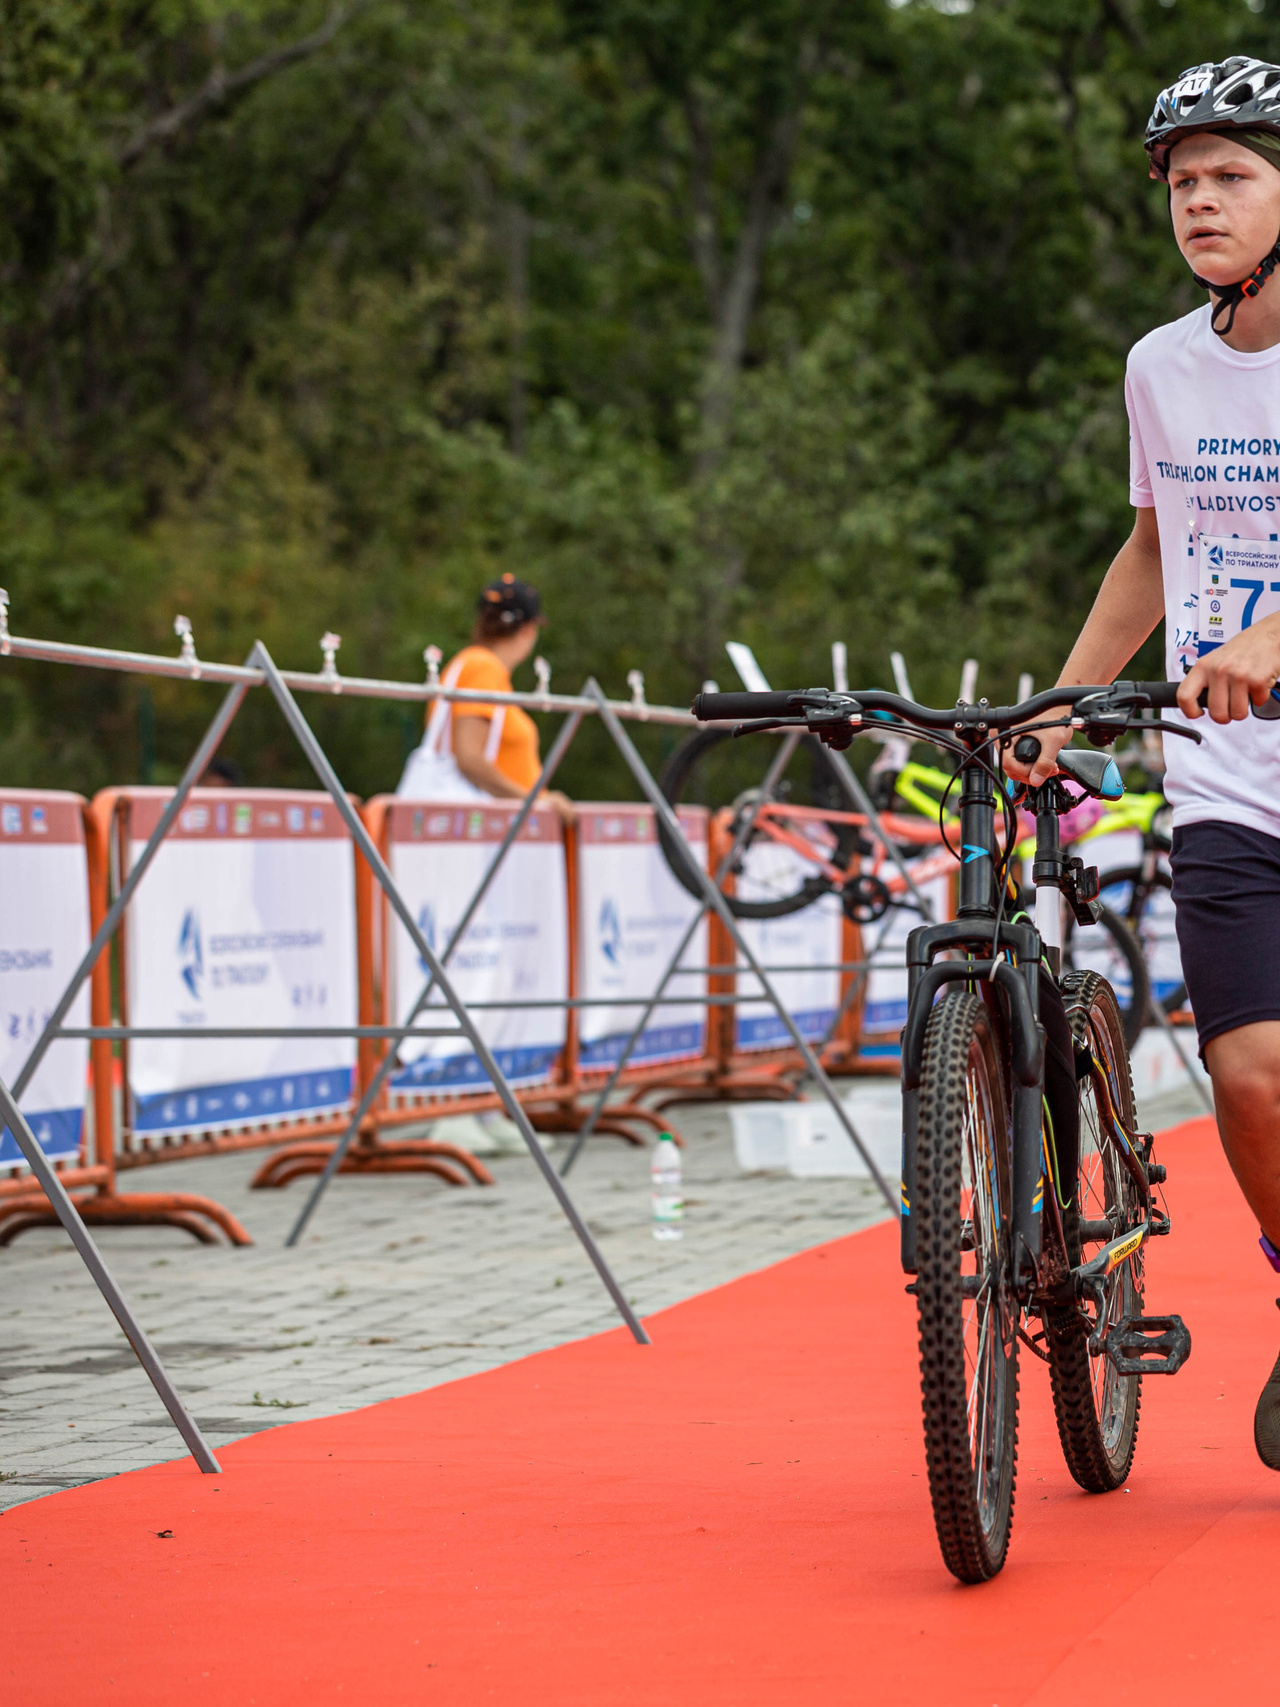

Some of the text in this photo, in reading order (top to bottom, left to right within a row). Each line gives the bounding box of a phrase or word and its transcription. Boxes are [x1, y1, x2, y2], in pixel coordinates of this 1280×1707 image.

[1180, 77, 1208, 92] 717
[1225, 550, 1277, 560] ВСЕРОССИЙСКИЕ
[1225, 558, 1279, 569] ПО ТРИАТЛОНУ
[1114, 1238, 1138, 1260] FORWARD
